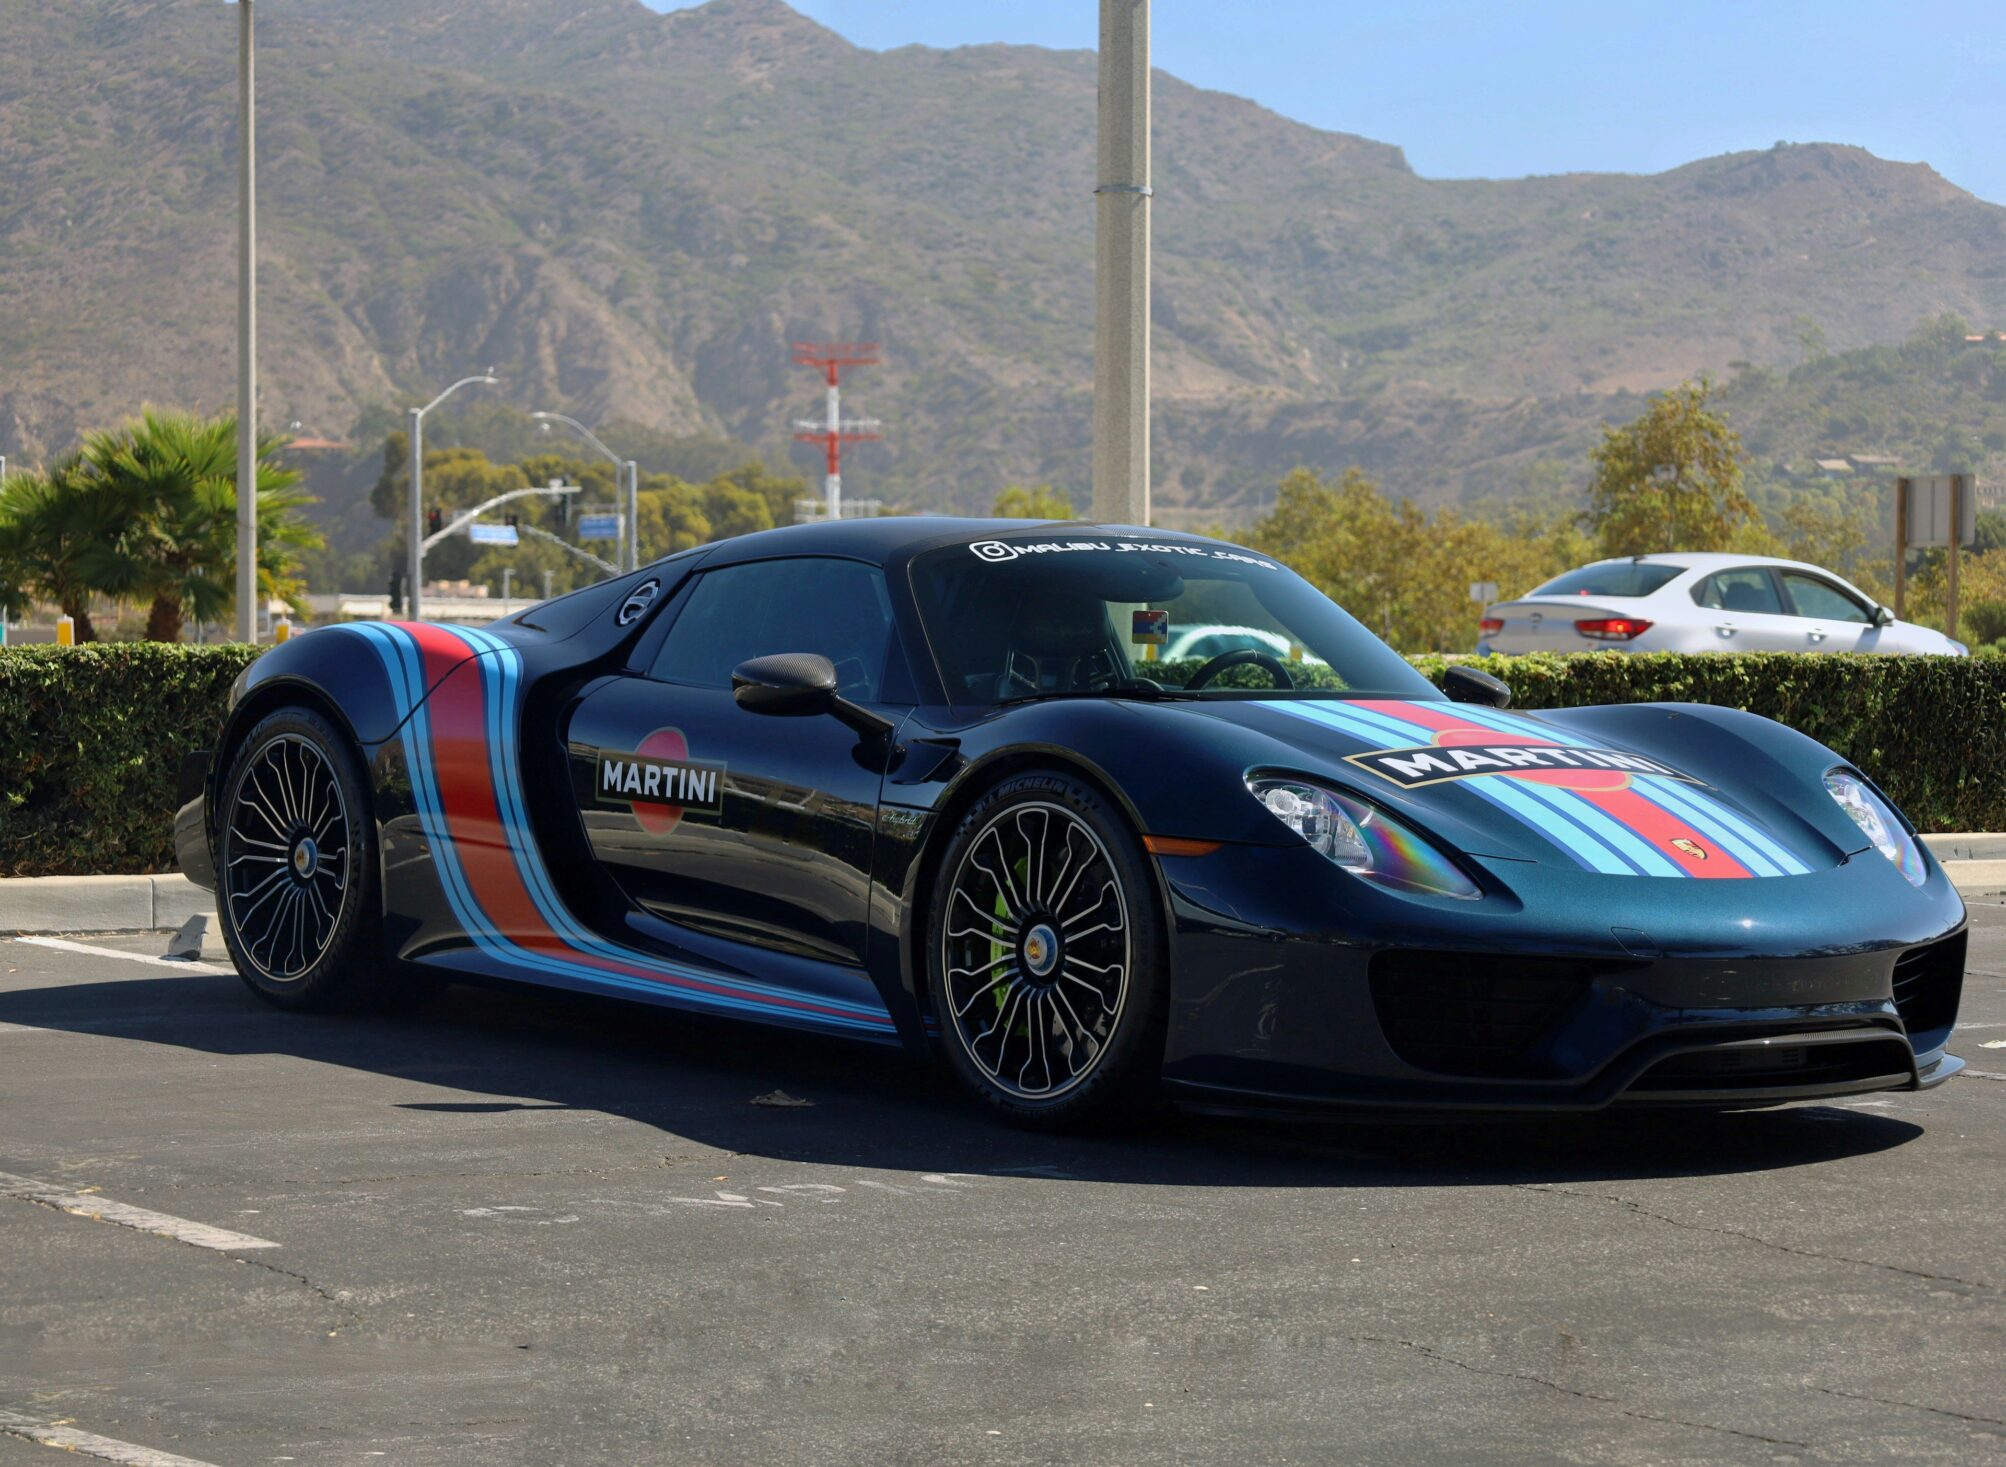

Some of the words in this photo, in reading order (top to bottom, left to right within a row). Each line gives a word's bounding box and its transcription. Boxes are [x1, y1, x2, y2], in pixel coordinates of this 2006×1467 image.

[1377, 746, 1675, 778] MARTINI
[603, 760, 717, 803] MARTINI
[998, 777, 1067, 796] MICHELIN
